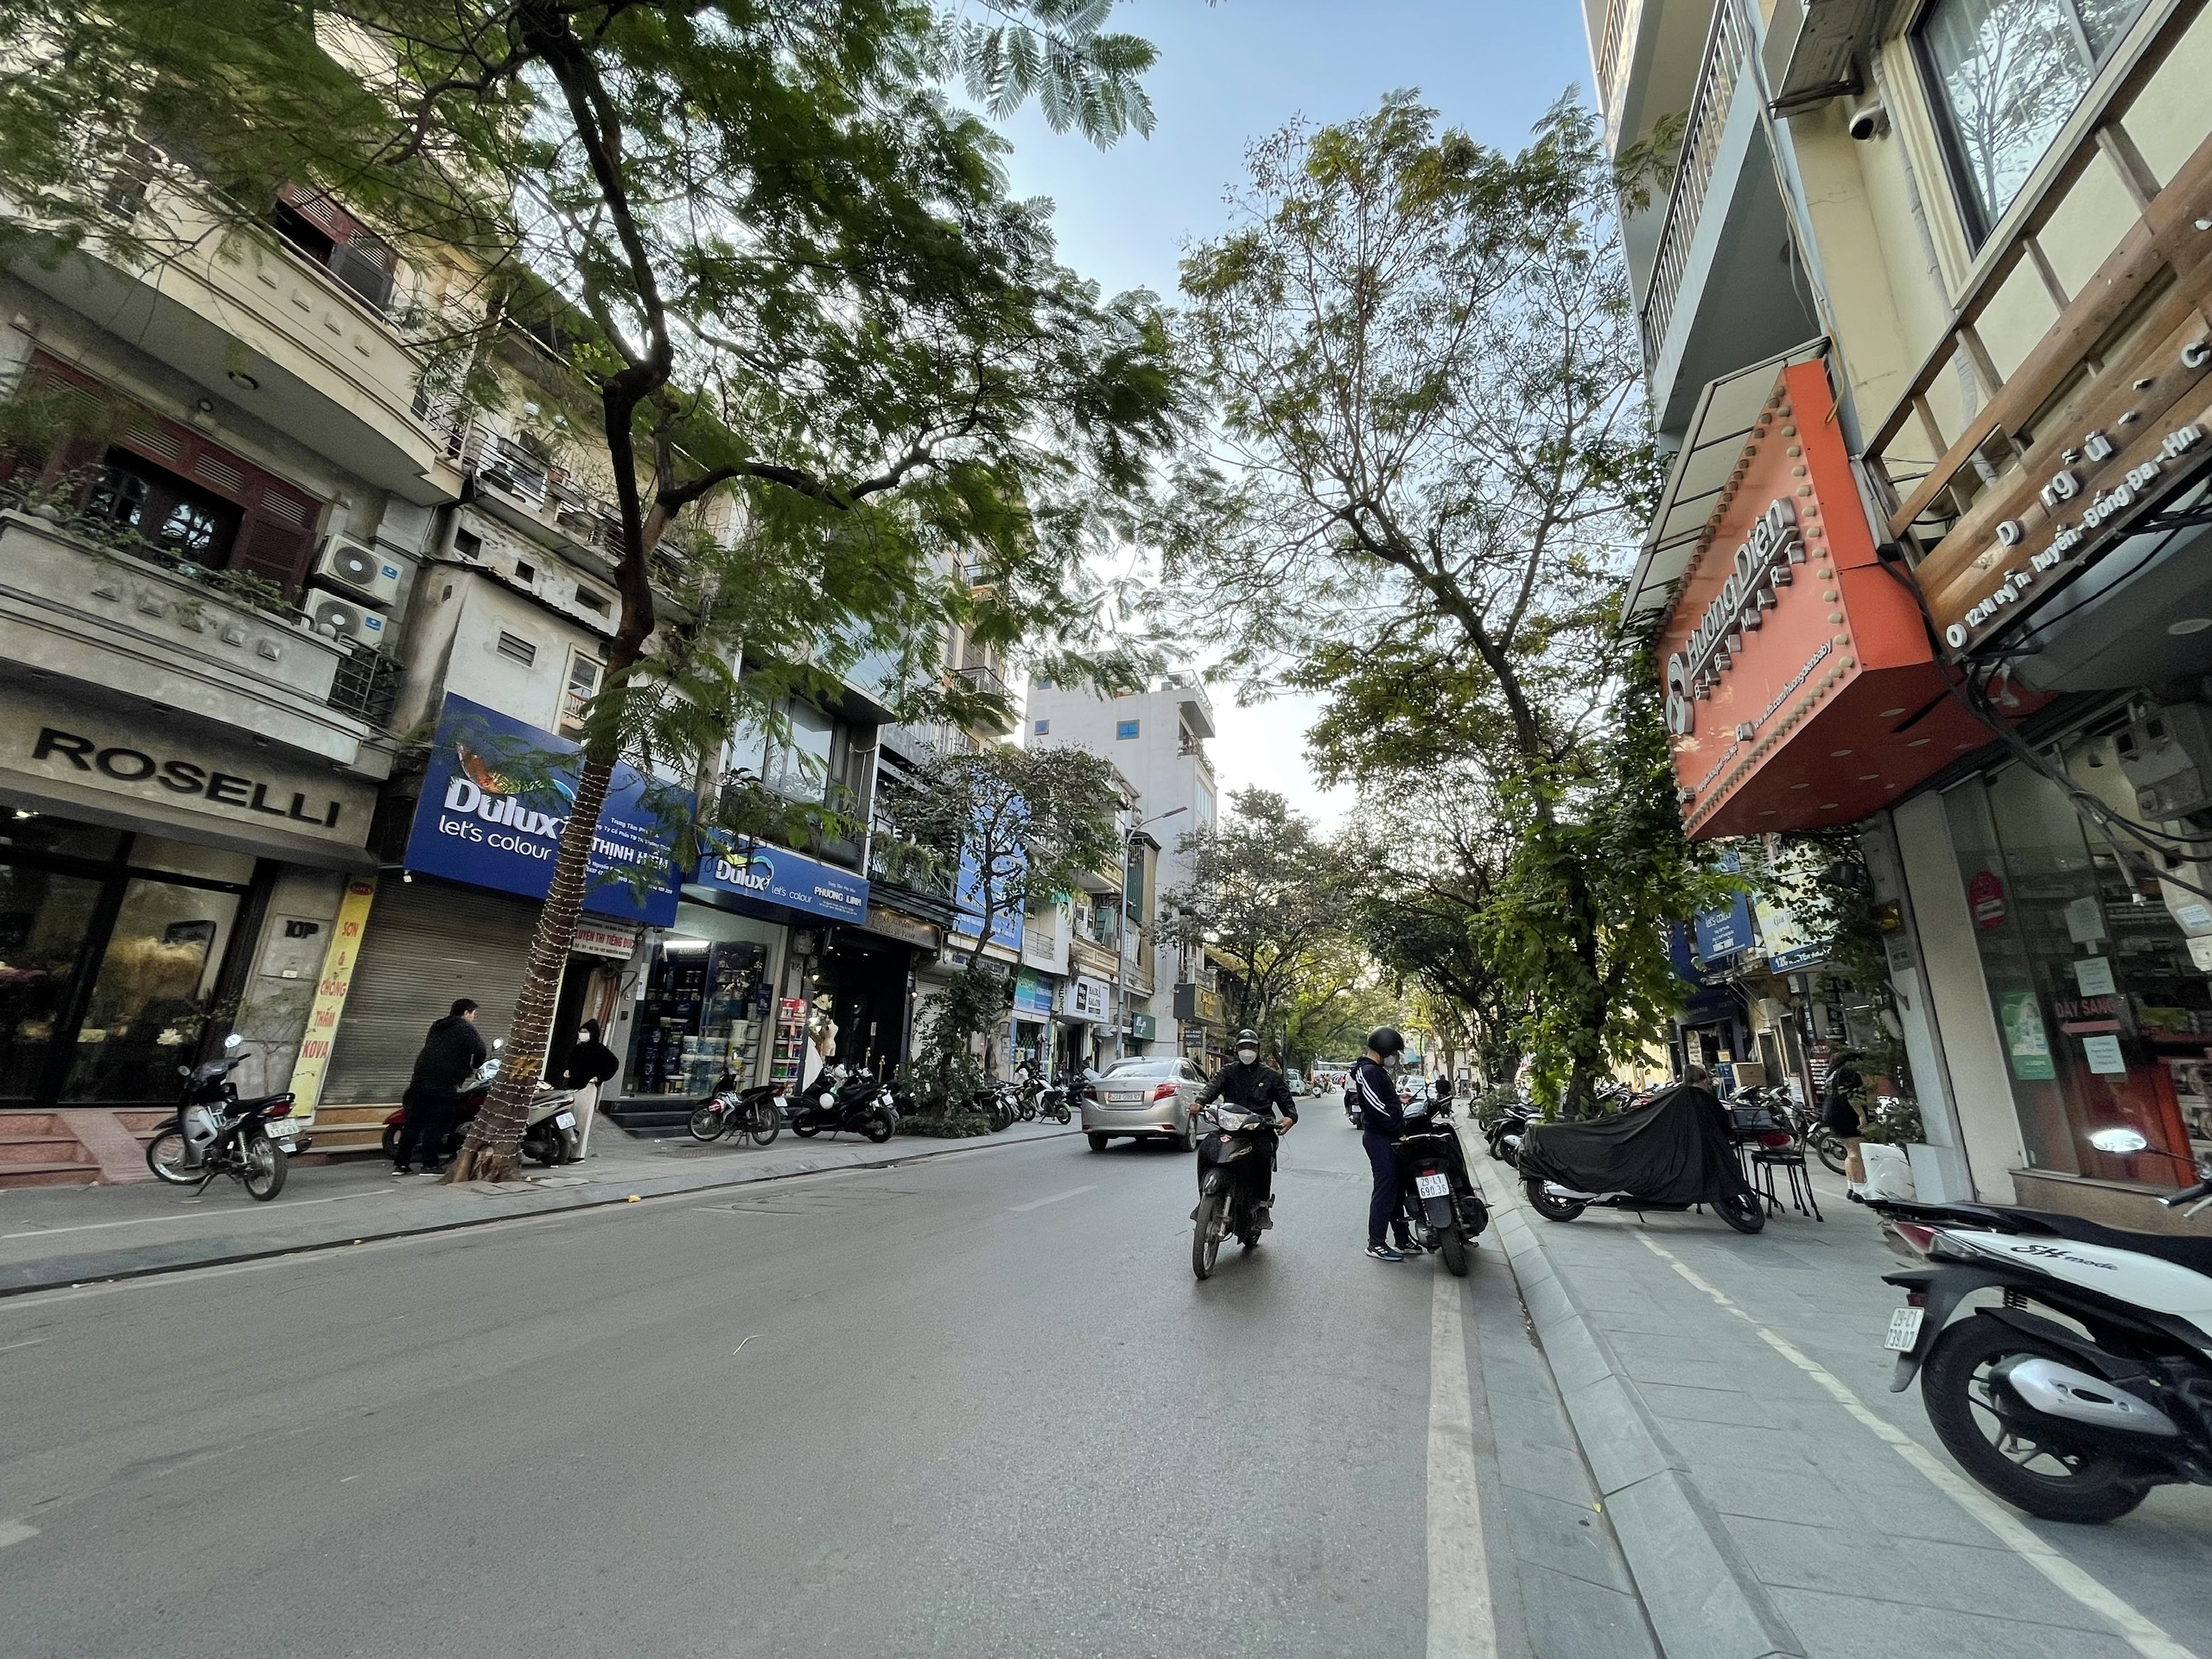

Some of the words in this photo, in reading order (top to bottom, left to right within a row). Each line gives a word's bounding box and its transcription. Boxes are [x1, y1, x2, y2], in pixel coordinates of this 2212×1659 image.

[1740, 543, 1798, 632] MART
[33, 728, 340, 828] ROSELLI
[444, 776, 557, 839] Dulux
[439, 815, 482, 842] let's
[487, 834, 552, 860] colour
[592, 836, 635, 862] THỊNH
[715, 859, 766, 892] Dulux
[789, 889, 812, 904] colour
[302, 1040, 329, 1059] KOVA
